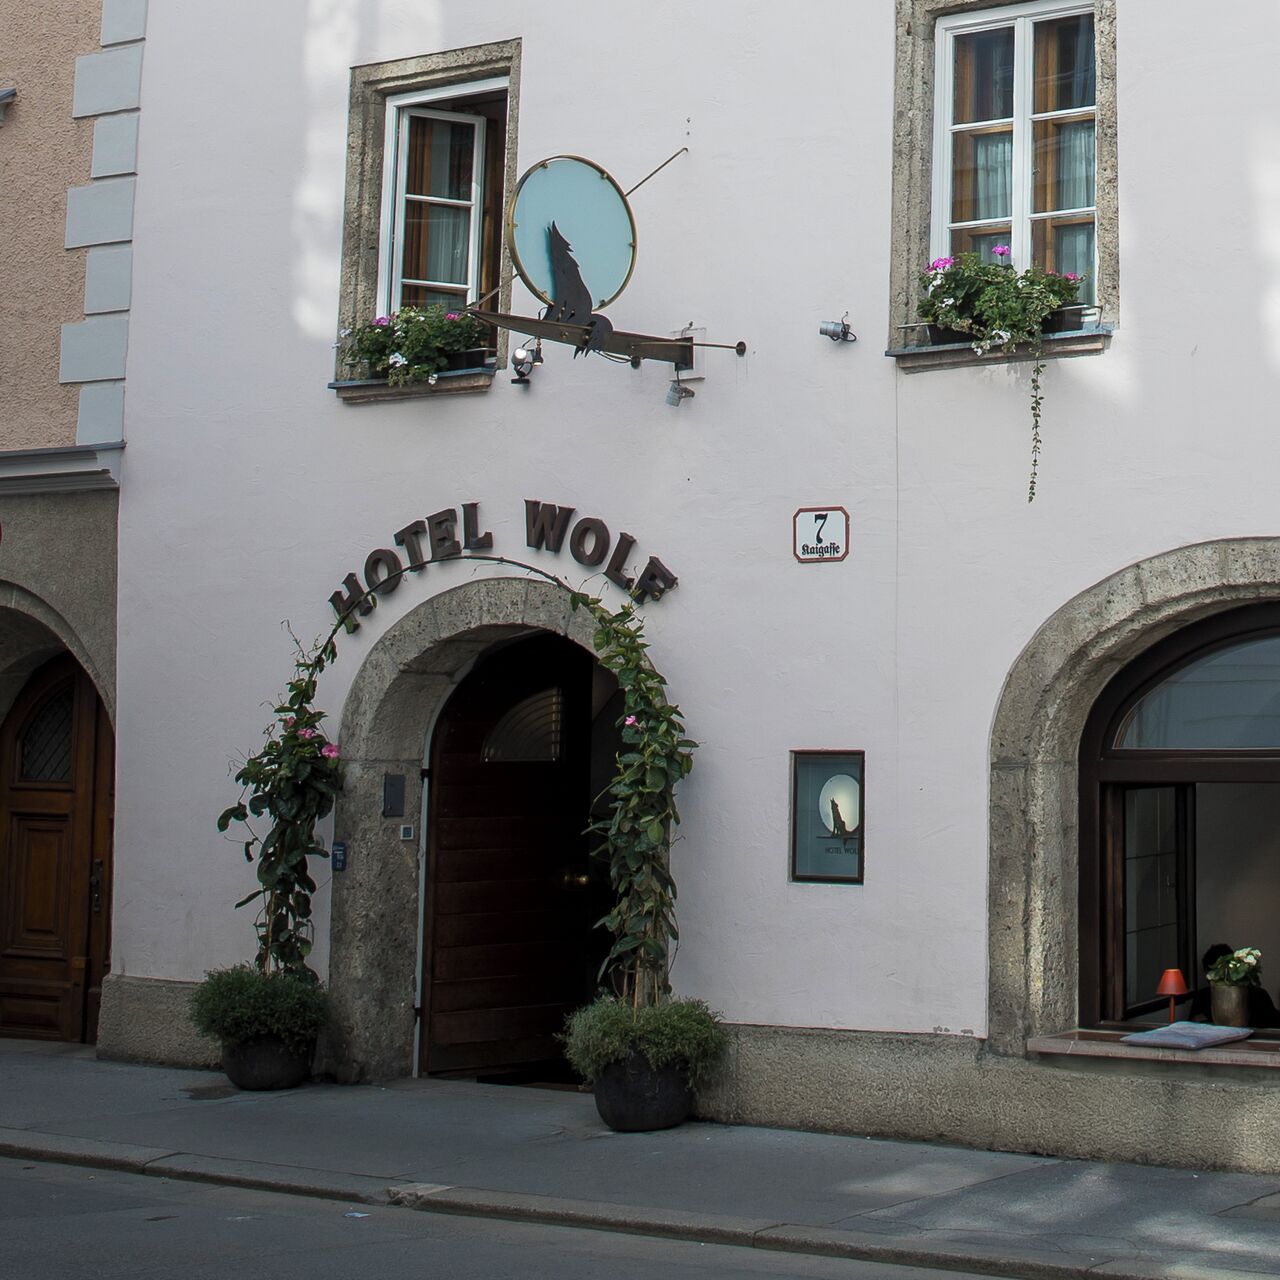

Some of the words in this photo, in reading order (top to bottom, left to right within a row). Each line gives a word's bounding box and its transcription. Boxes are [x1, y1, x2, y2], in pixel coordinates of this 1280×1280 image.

[814, 513, 828, 544] 7
[328, 502, 494, 635] HOTEL
[523, 498, 679, 605] WOLF
[845, 847, 858, 855] WOL
